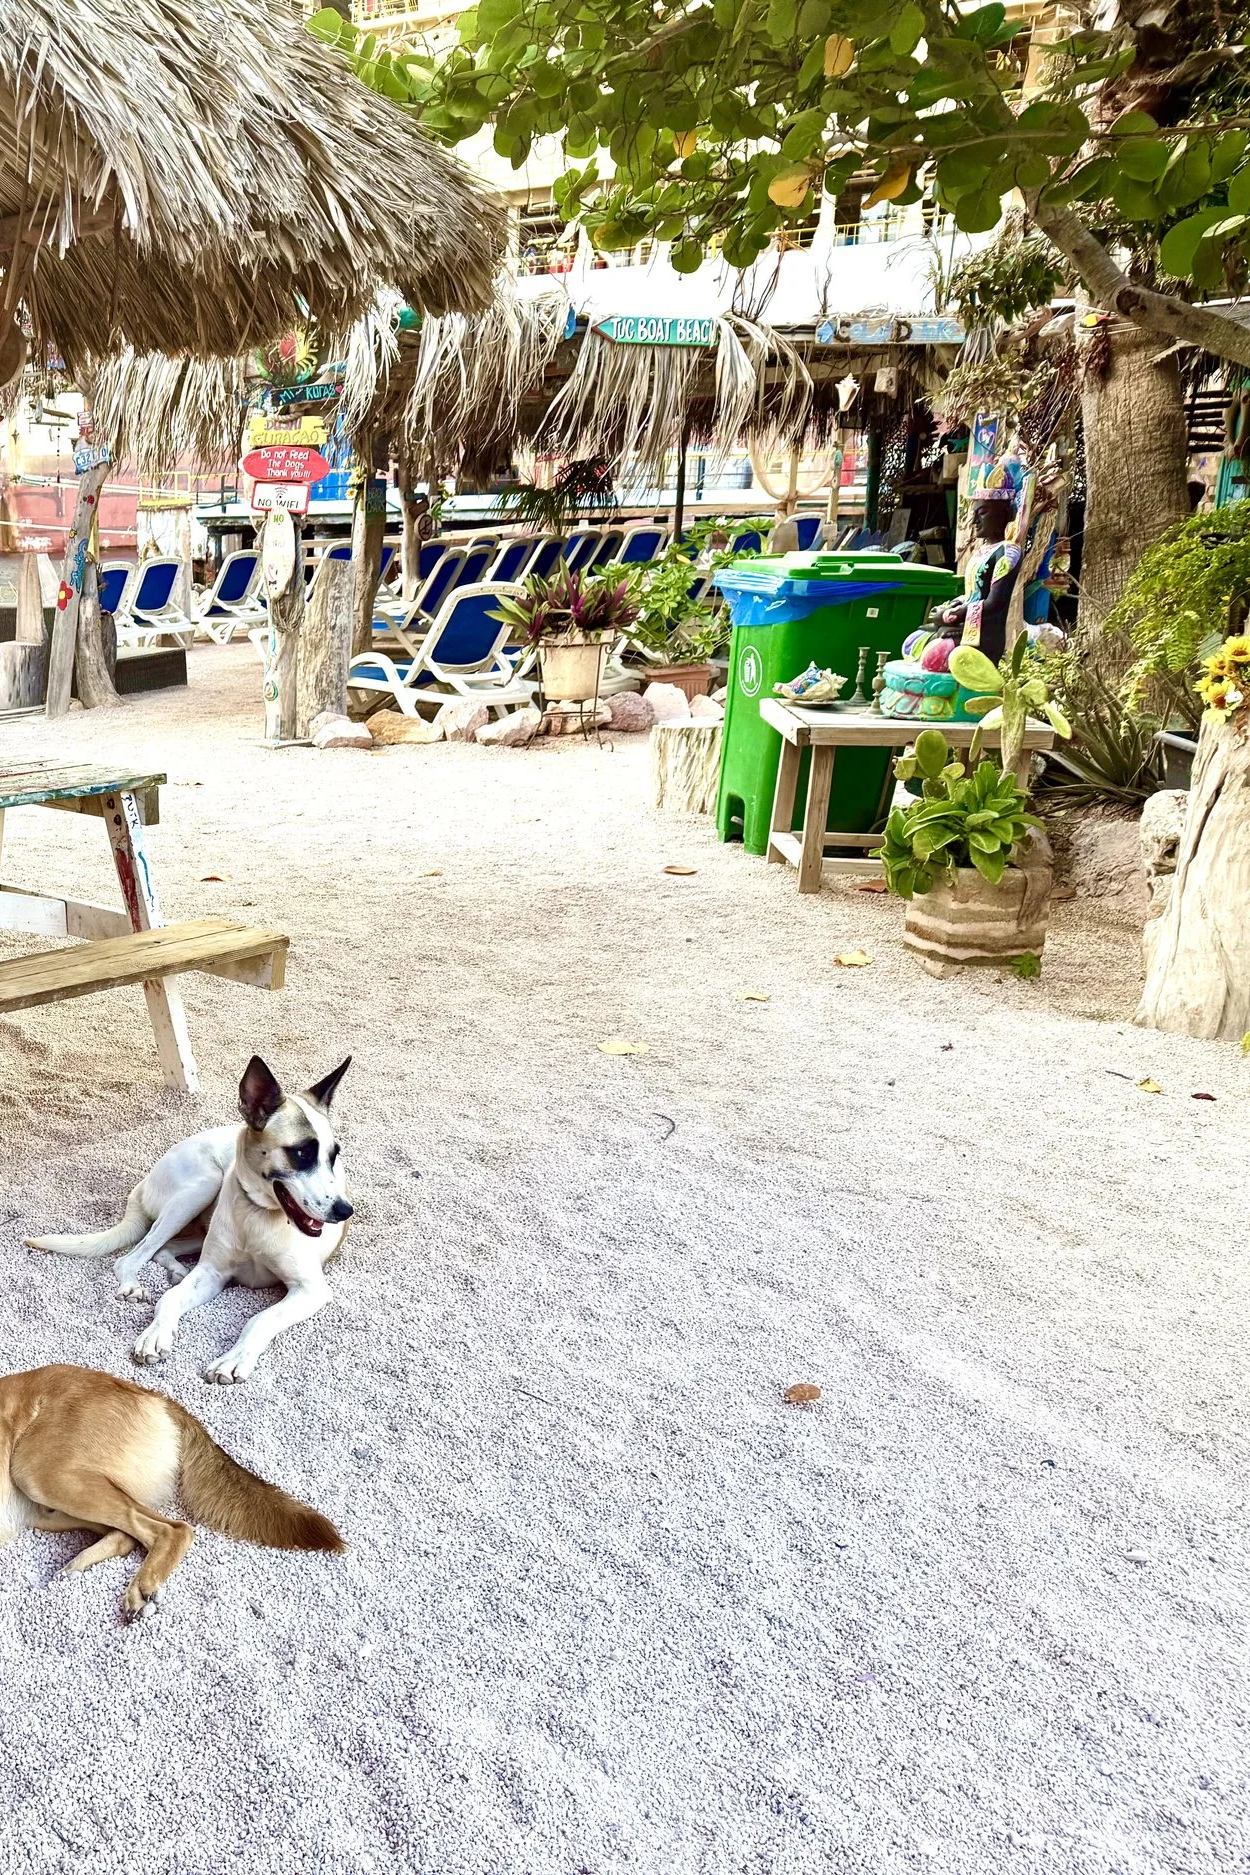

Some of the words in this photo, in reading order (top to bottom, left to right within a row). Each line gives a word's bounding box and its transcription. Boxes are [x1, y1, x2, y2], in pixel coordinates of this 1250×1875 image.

[610, 316, 635, 341] TUG
[637, 317, 673, 342] BOAT
[261, 450, 271, 459] Do
[273, 450, 286, 459] not
[290, 449, 309, 460] Feed
[268, 460, 281, 468] The
[285, 460, 304, 471] Dogs
[267, 468, 288, 477] Thank
[258, 498, 272, 507] NO
[276, 499, 299, 509] WIFI
